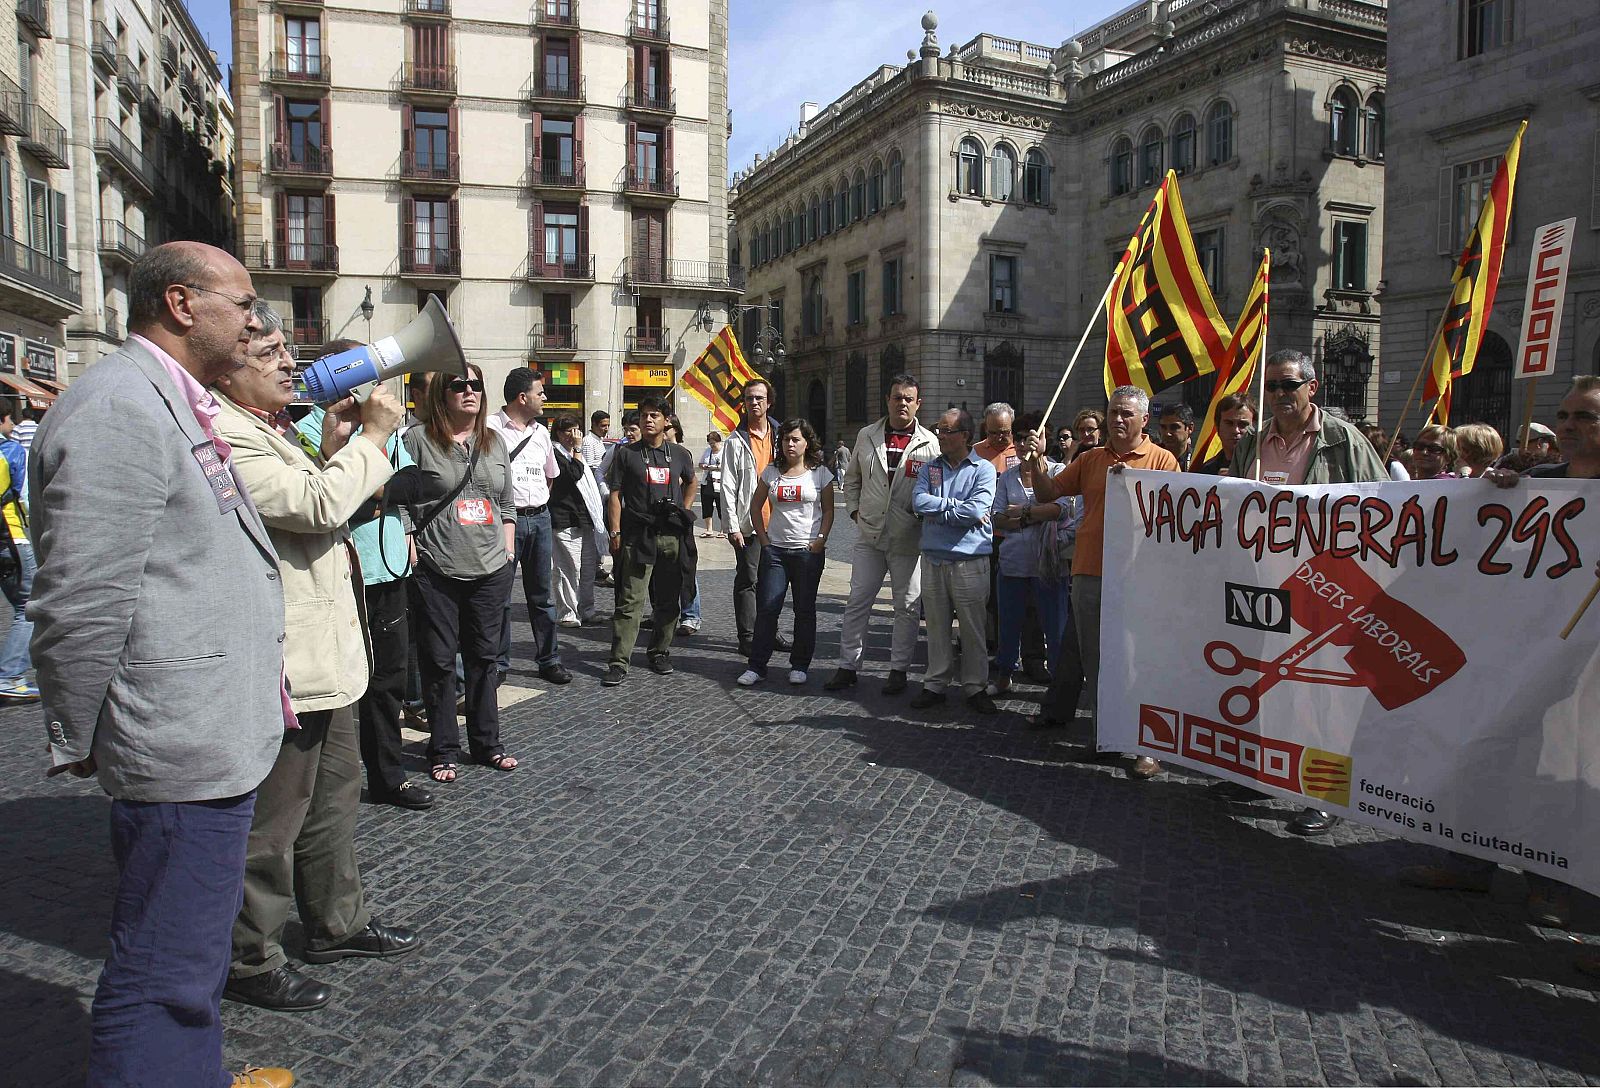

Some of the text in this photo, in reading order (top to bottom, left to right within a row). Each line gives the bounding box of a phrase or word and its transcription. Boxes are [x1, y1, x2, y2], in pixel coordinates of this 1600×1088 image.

[1522, 246, 1564, 374] CCOO
[649, 369, 668, 378] pans
[1135, 480, 1586, 579] VAGA GENERAL 29S
[1230, 588, 1283, 627] NO
[1296, 561, 1441, 684] DRETS LABORALS
[1189, 724, 1291, 780] CCOO
[1359, 778, 1435, 814] federació
[1357, 801, 1569, 870] serveis a la ciutadania
